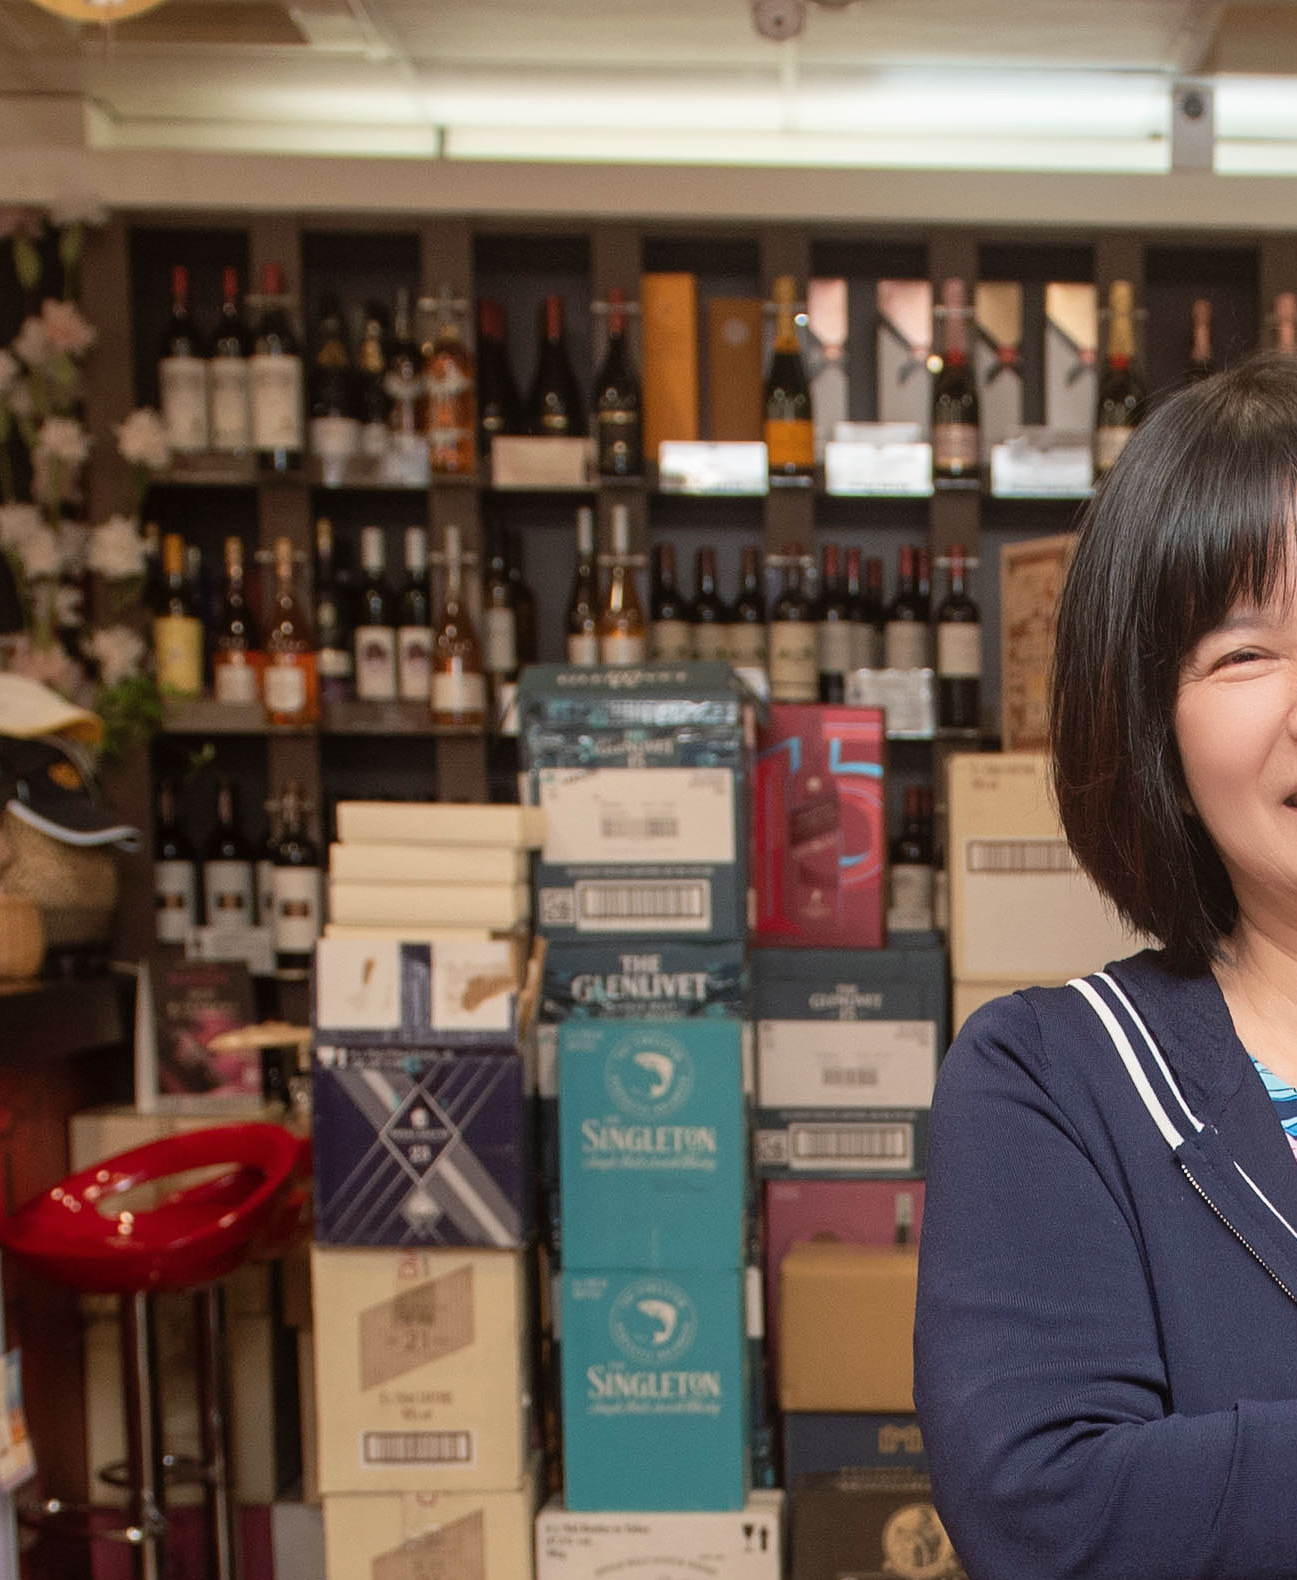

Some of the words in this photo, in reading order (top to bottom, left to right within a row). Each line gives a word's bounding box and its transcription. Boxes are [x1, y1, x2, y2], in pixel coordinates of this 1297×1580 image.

[620, 954, 661, 972] THE
[571, 972, 709, 1001] GLENLIVET
[582, 1118, 718, 1154] SINGLETON
[586, 1364, 722, 1398] SINGLETON
